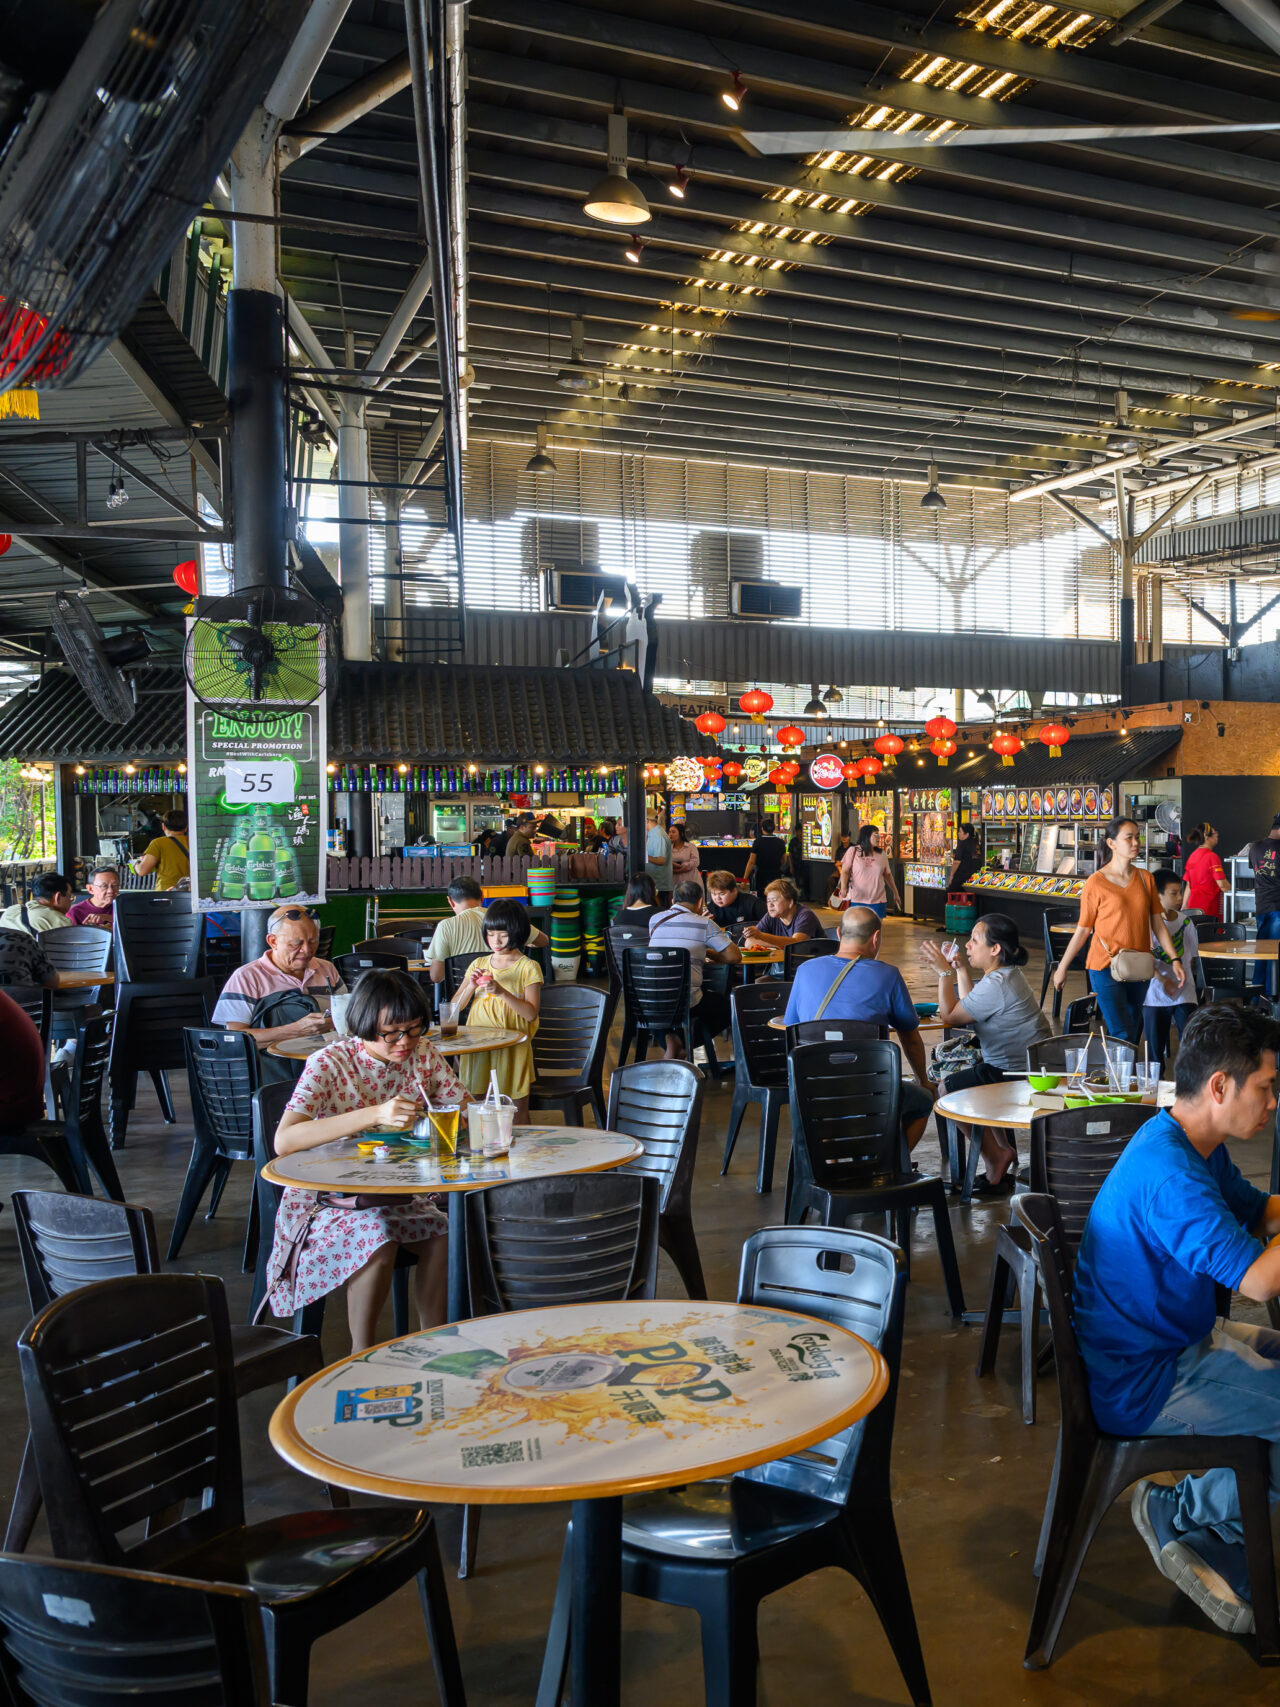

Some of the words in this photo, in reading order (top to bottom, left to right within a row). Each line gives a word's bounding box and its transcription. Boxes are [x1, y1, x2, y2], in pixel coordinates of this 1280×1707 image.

[211, 709, 304, 739] ENJOY!
[212, 741, 249, 749] SPECIAL
[251, 742, 303, 750] PROMOTION
[240, 773, 273, 792] 55
[786, 1333, 833, 1368] Carlsberg
[608, 1341, 733, 1402] POP
[430, 1393, 444, 1406] YOU
[431, 1406, 446, 1420] CAN
